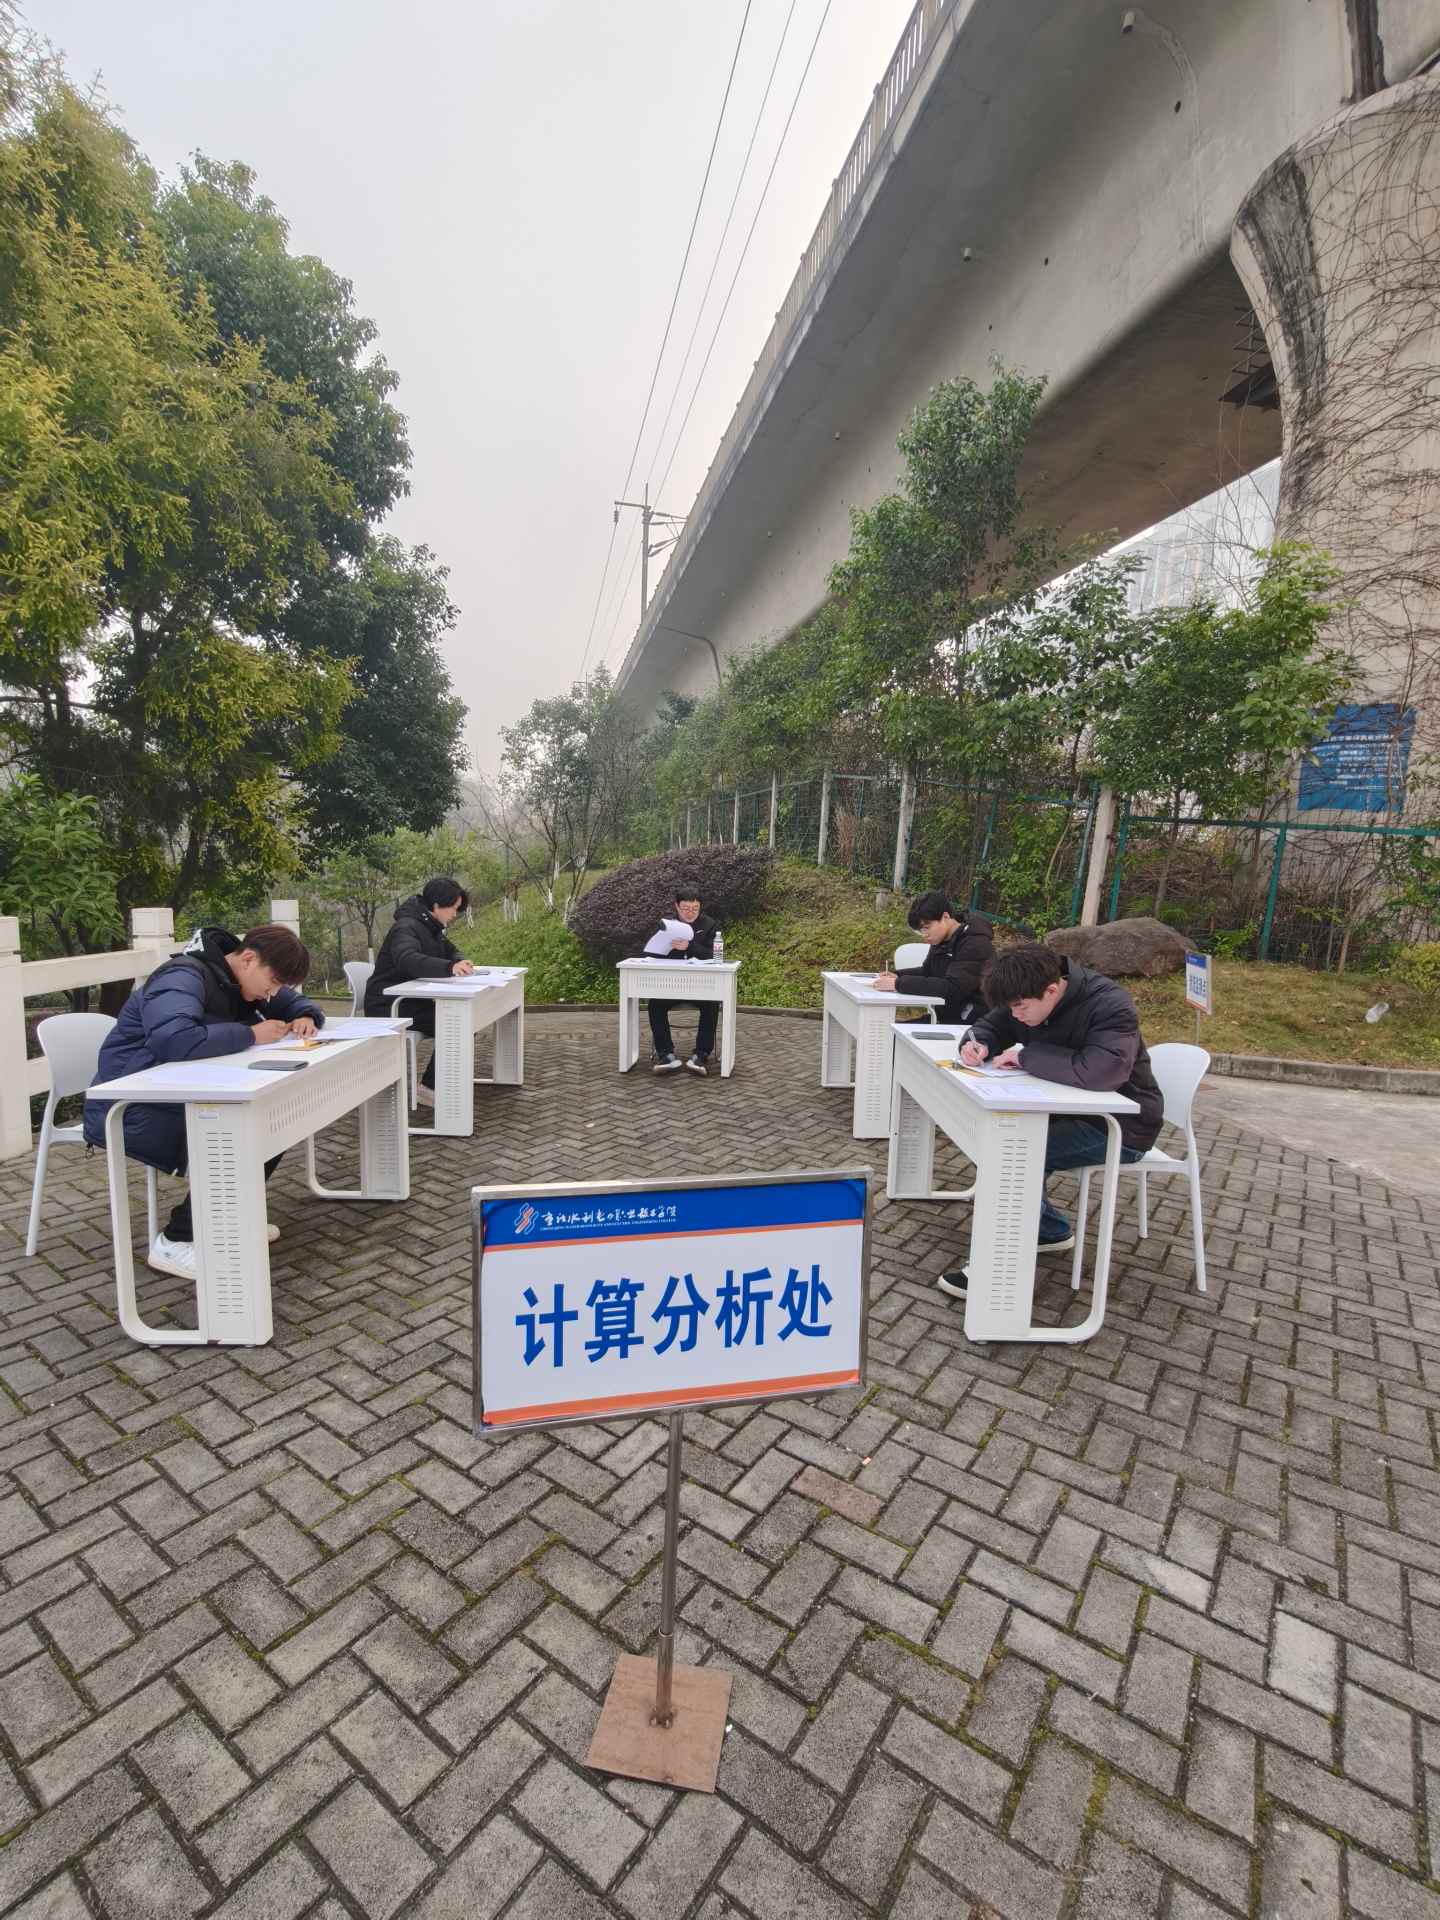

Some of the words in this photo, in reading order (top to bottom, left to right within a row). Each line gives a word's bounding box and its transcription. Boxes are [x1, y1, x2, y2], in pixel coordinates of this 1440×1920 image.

[515, 1264, 833, 1367] 计算分析处
